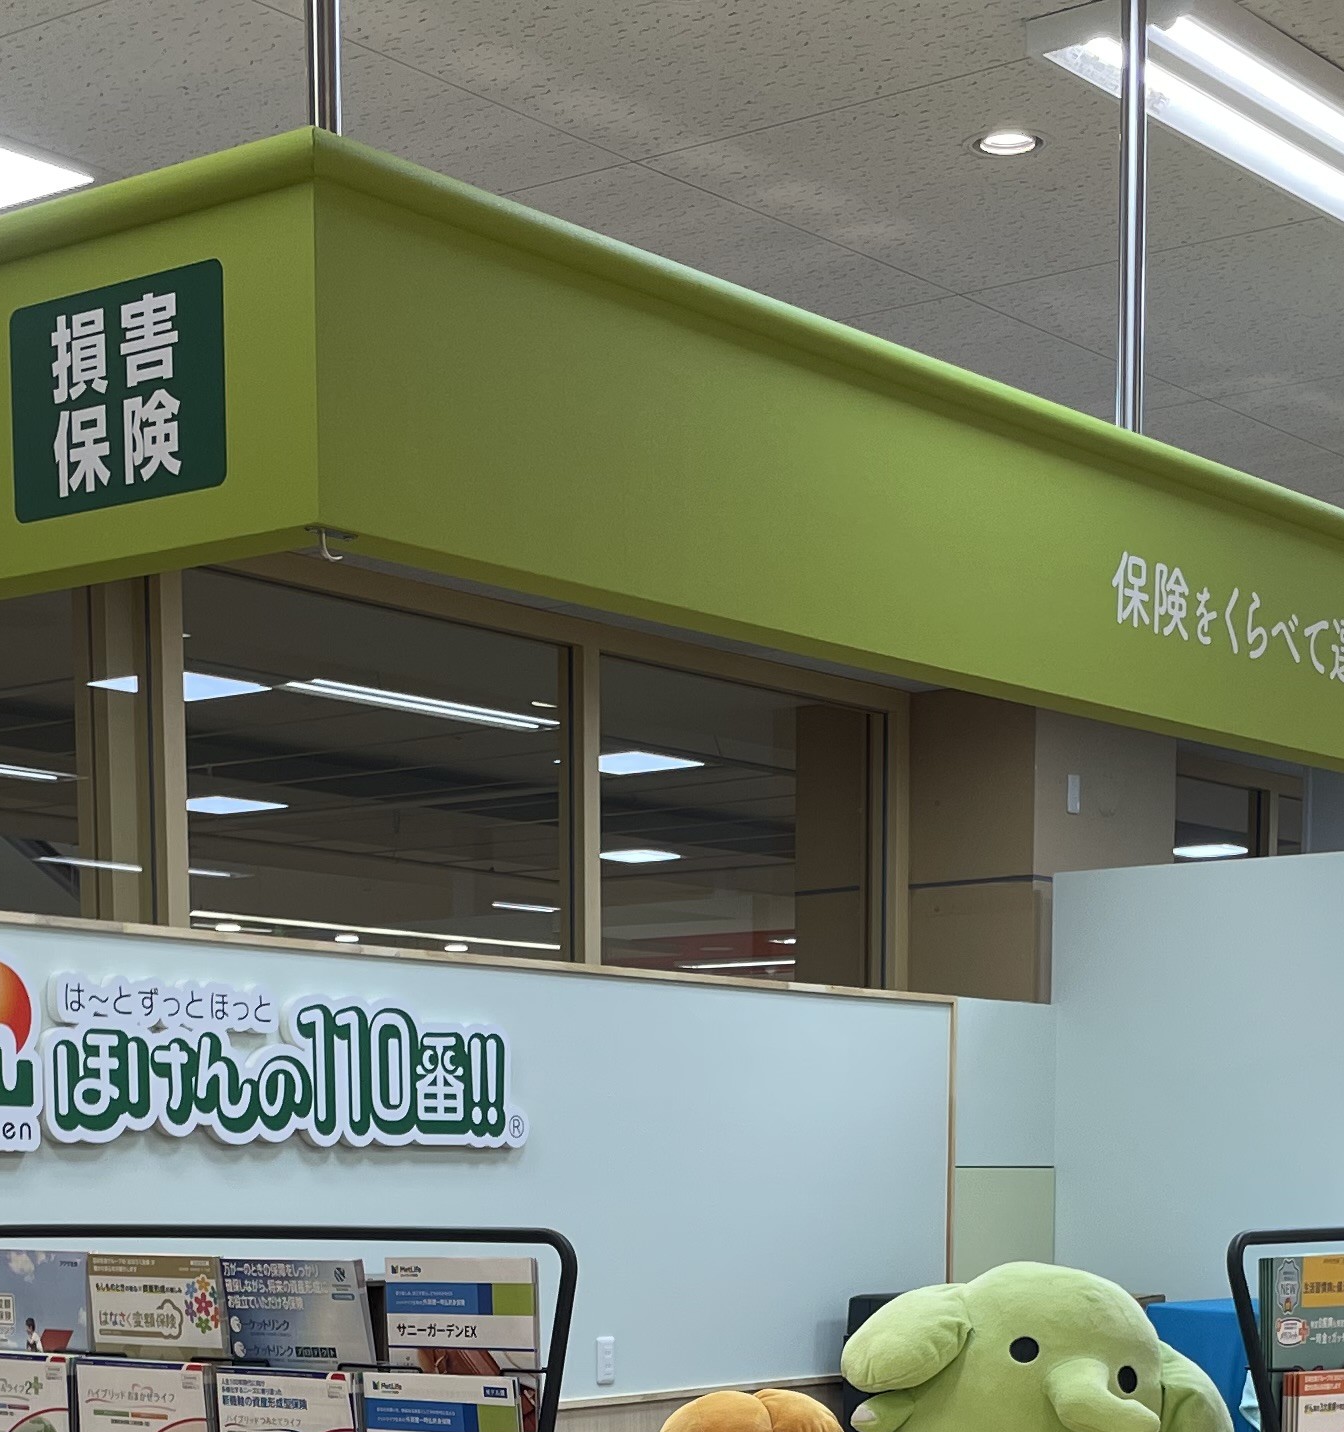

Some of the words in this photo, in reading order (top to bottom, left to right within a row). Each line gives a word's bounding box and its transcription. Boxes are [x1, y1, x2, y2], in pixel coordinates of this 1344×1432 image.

[51, 292, 179, 404] 損害
[54, 389, 182, 497] 保険
[397, 1323, 477, 1338] サニーガーデンEX
